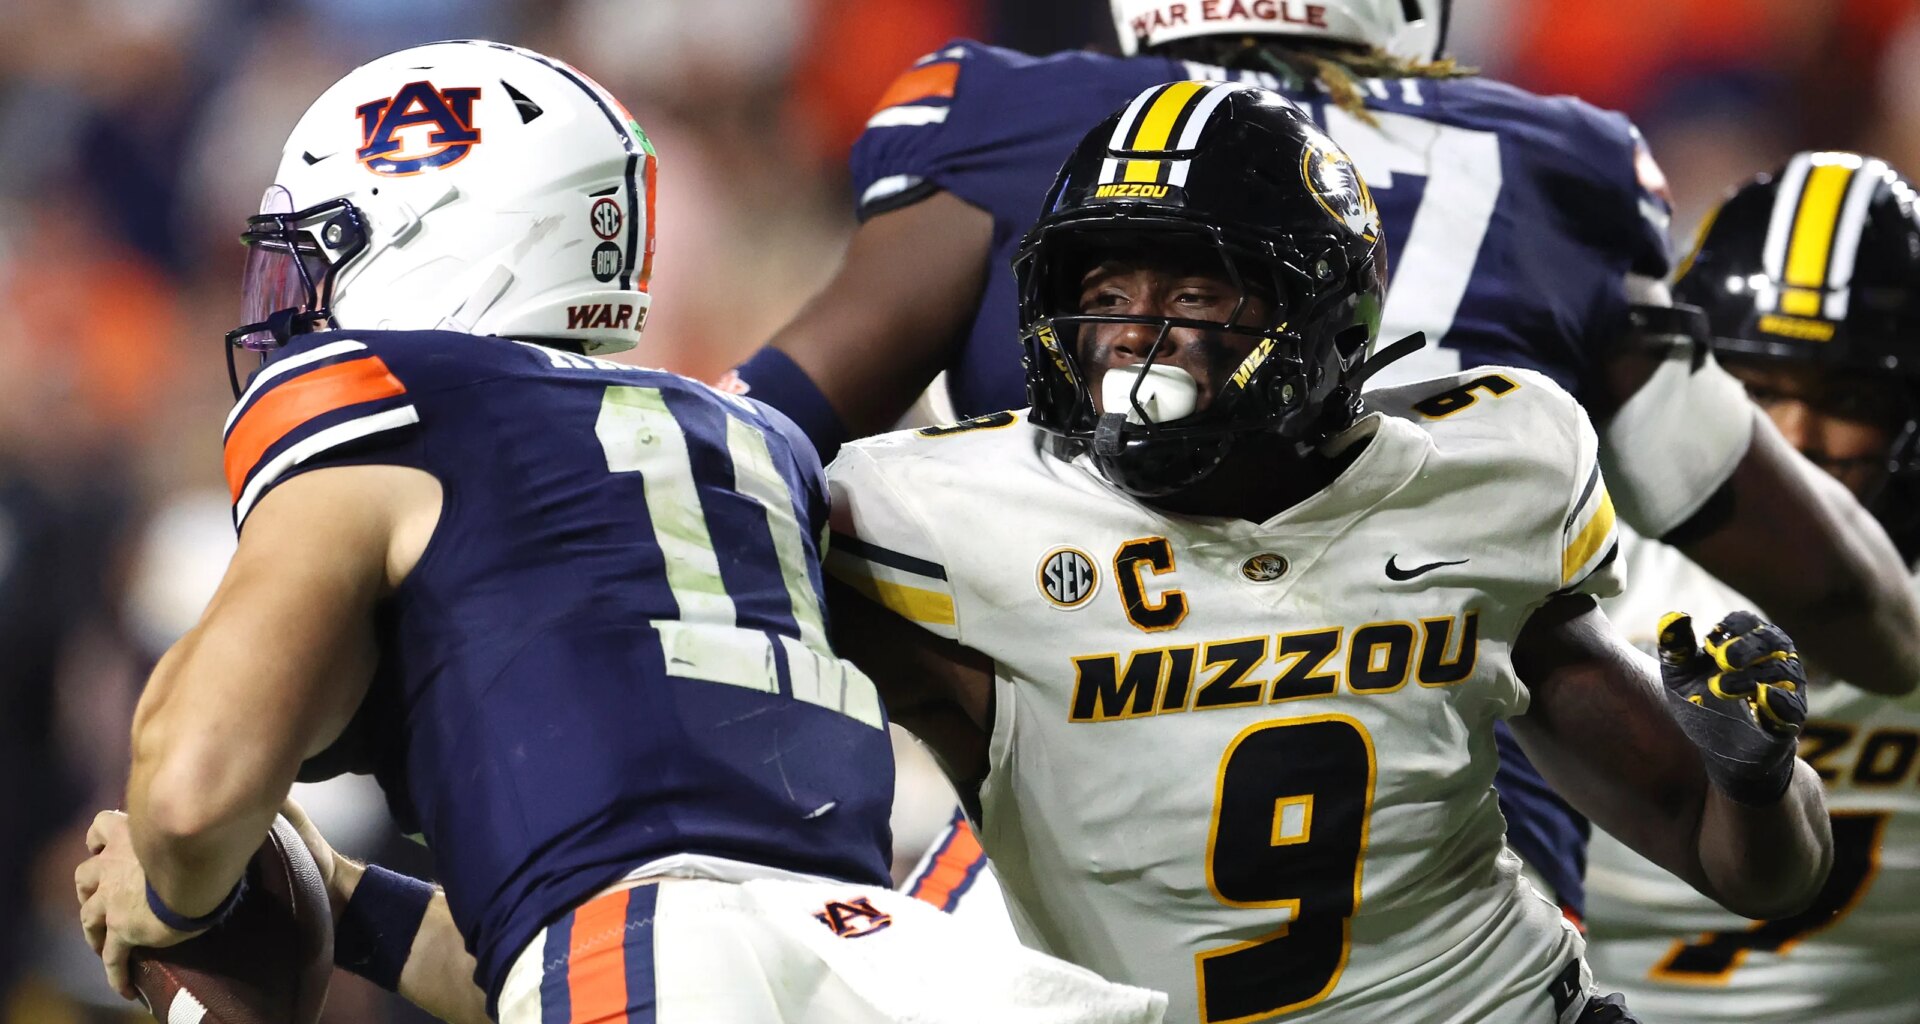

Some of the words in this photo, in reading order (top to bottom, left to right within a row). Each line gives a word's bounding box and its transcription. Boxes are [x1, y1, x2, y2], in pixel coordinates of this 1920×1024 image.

[1131, 3, 1188, 35] WAR
[1202, 0, 1328, 29] EAGLE
[1095, 183, 1169, 198] MIZZOU
[594, 201, 620, 237] SEC
[596, 250, 619, 275] BCW
[566, 303, 633, 330] WAR
[1233, 321, 1288, 390] MIZZ
[594, 385, 885, 731] 11
[1044, 551, 1091, 603] SEC
[1113, 536, 1190, 634] C
[1068, 609, 1480, 723] MIZZOU
[1196, 713, 1377, 1024] 9
